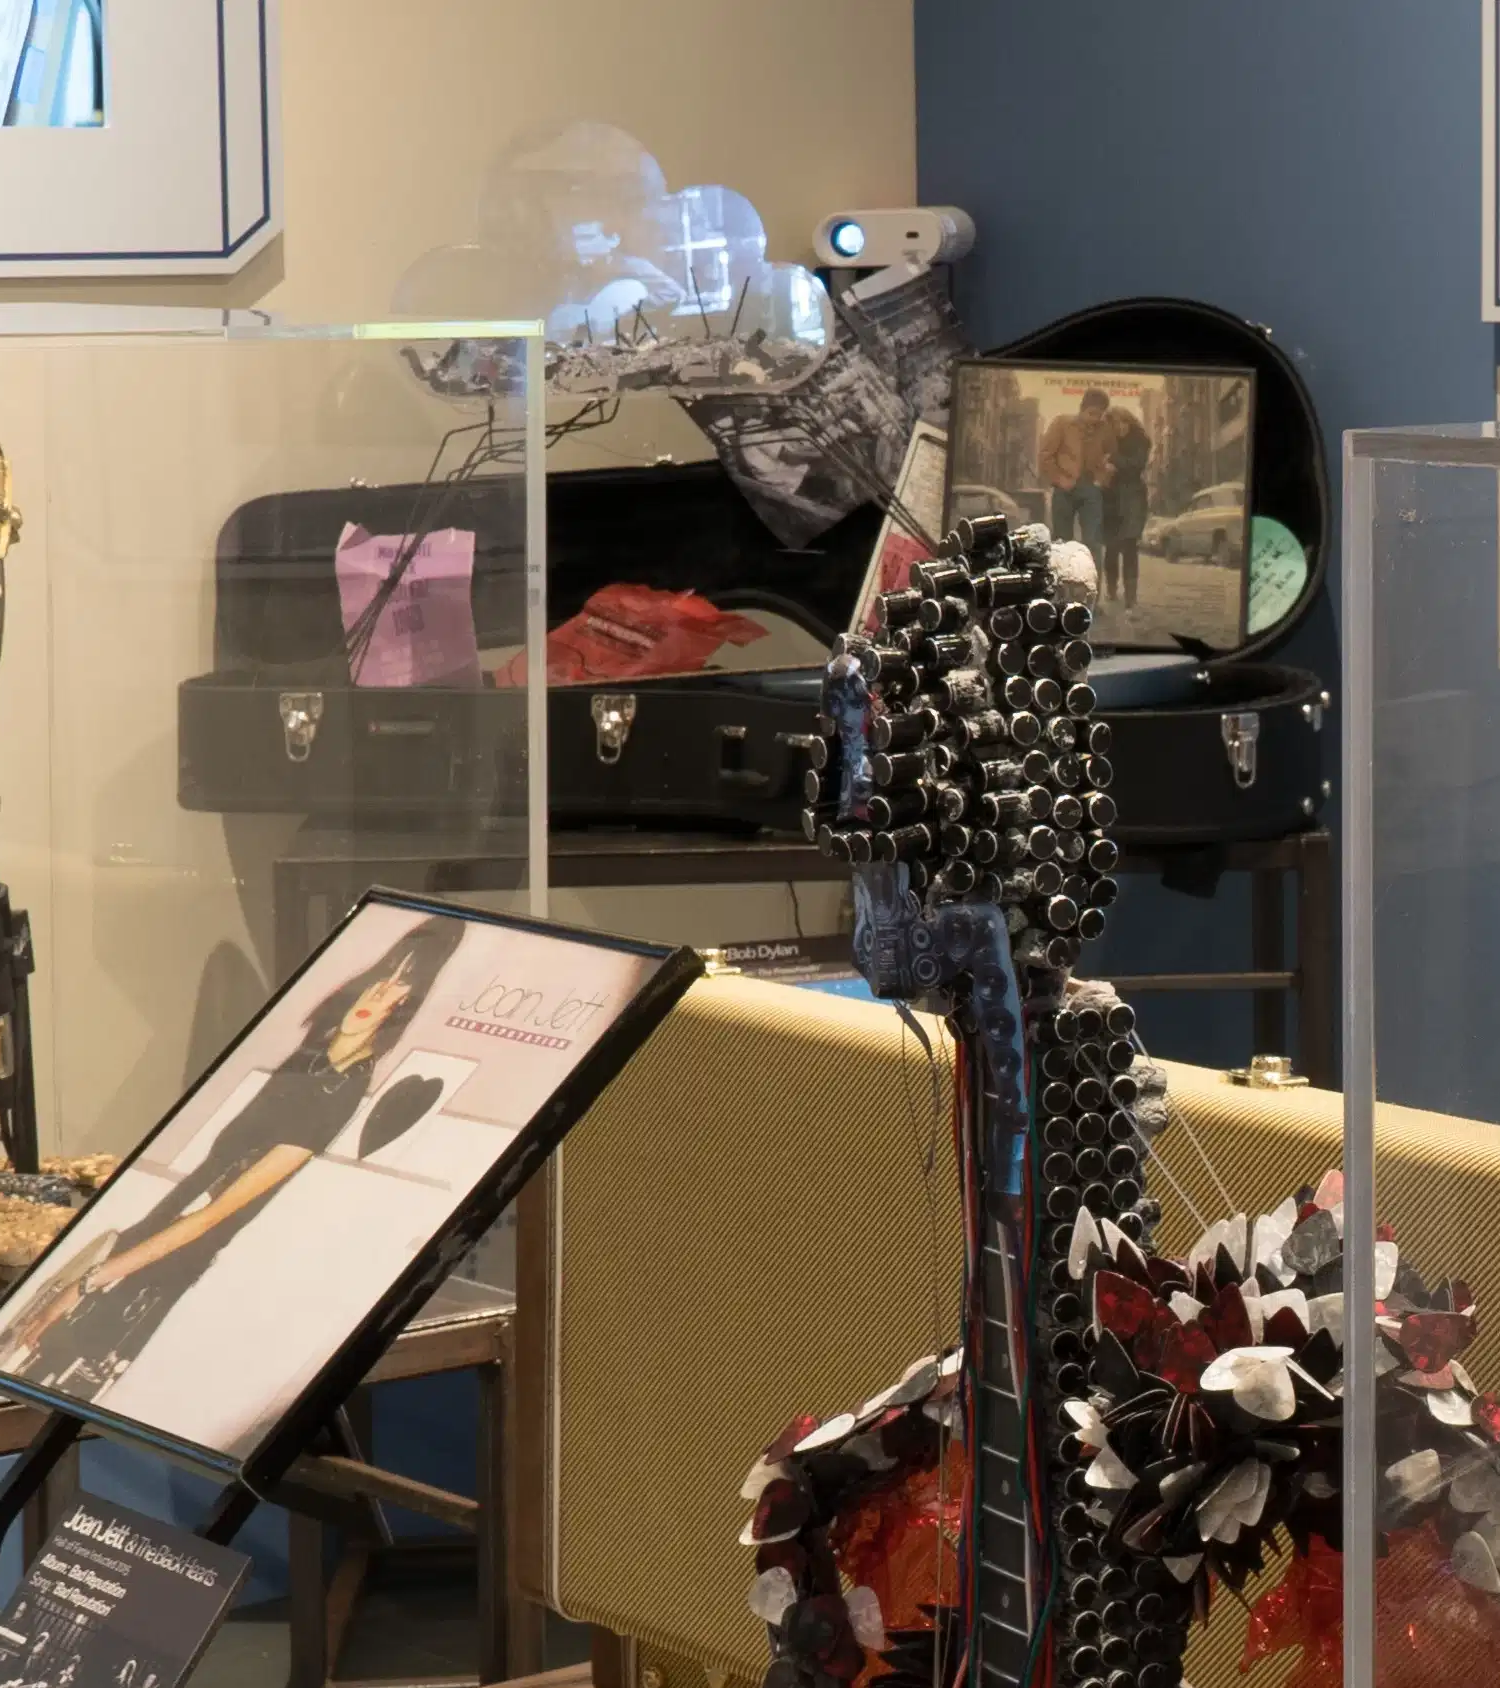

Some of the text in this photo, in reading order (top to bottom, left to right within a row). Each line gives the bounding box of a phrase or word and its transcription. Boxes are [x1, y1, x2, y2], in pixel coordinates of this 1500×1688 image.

[727, 944, 799, 960] Bob Dylan
[459, 975, 609, 1033] Joan Jett
[63, 1505, 157, 1562] Joan Jett & The
[39, 1553, 70, 1574] Album:
[82, 1570, 126, 1598] Reputation
